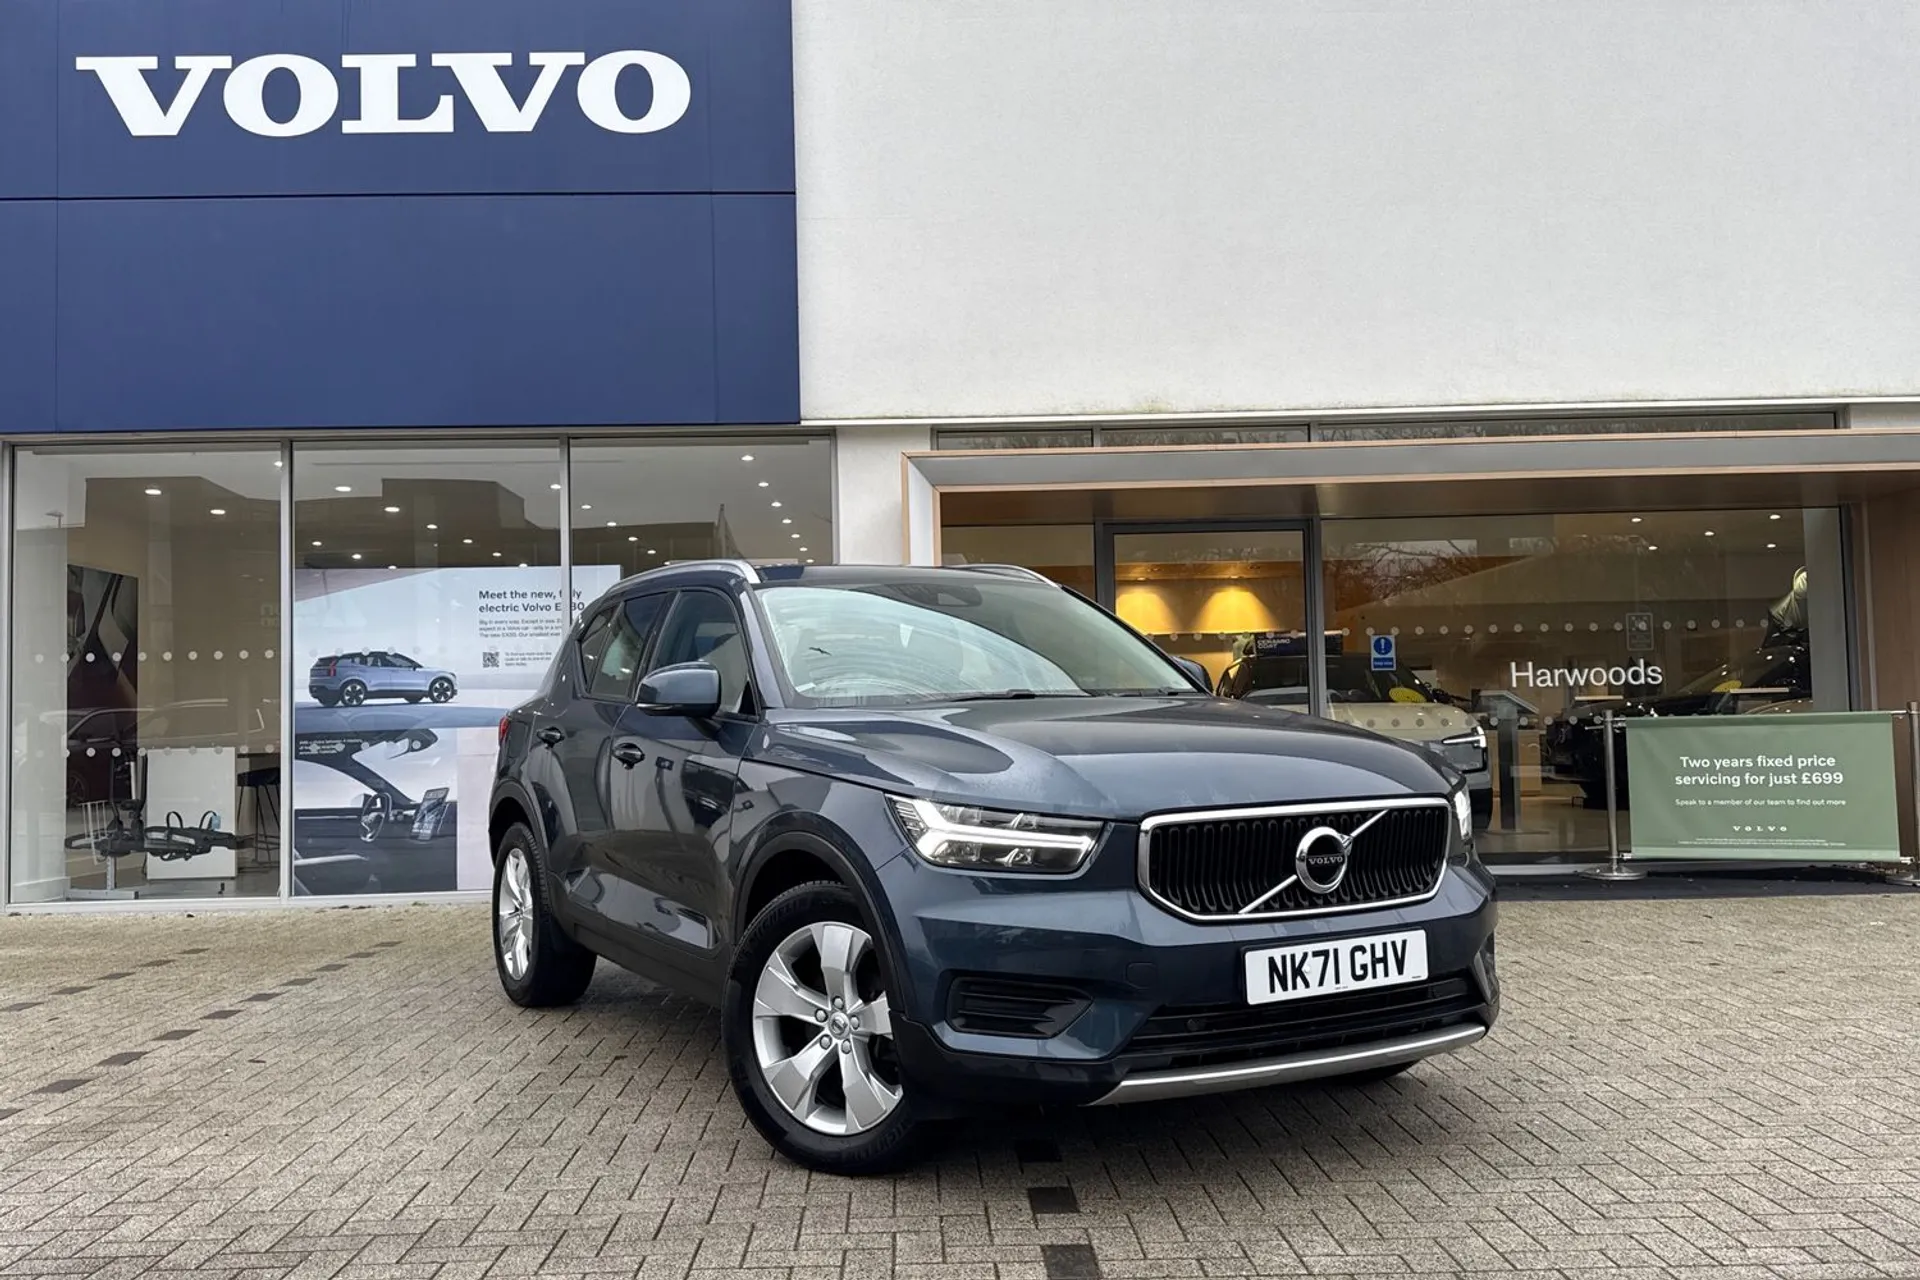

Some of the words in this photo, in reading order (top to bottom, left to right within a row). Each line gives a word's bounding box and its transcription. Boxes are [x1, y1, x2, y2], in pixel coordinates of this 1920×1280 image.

[75, 50, 691, 137] VOLVO
[479, 590, 507, 599] Meet
[510, 590, 528, 599] the
[531, 591, 556, 600] new,
[559, 589, 582, 599] fly
[479, 603, 519, 612] electric
[521, 602, 552, 612] Volvo
[555, 601, 585, 612] E30
[1510, 658, 1663, 688] Harwoods
[1680, 756, 1711, 768] Two
[1713, 757, 1753, 770] years
[1756, 755, 1793, 767] fixed
[1797, 754, 1836, 769] price
[1675, 773, 1741, 787] servicing
[1744, 773, 1766, 785] for
[1768, 773, 1798, 787] just
[1801, 772, 1844, 785] £699
[1675, 799, 1697, 807] Speak
[1744, 798, 1752, 806] of
[1796, 798, 1811, 806] find
[1308, 856, 1343, 865] VOLVO
[1267, 947, 1341, 994] NK71
[1350, 939, 1408, 982] GHV
